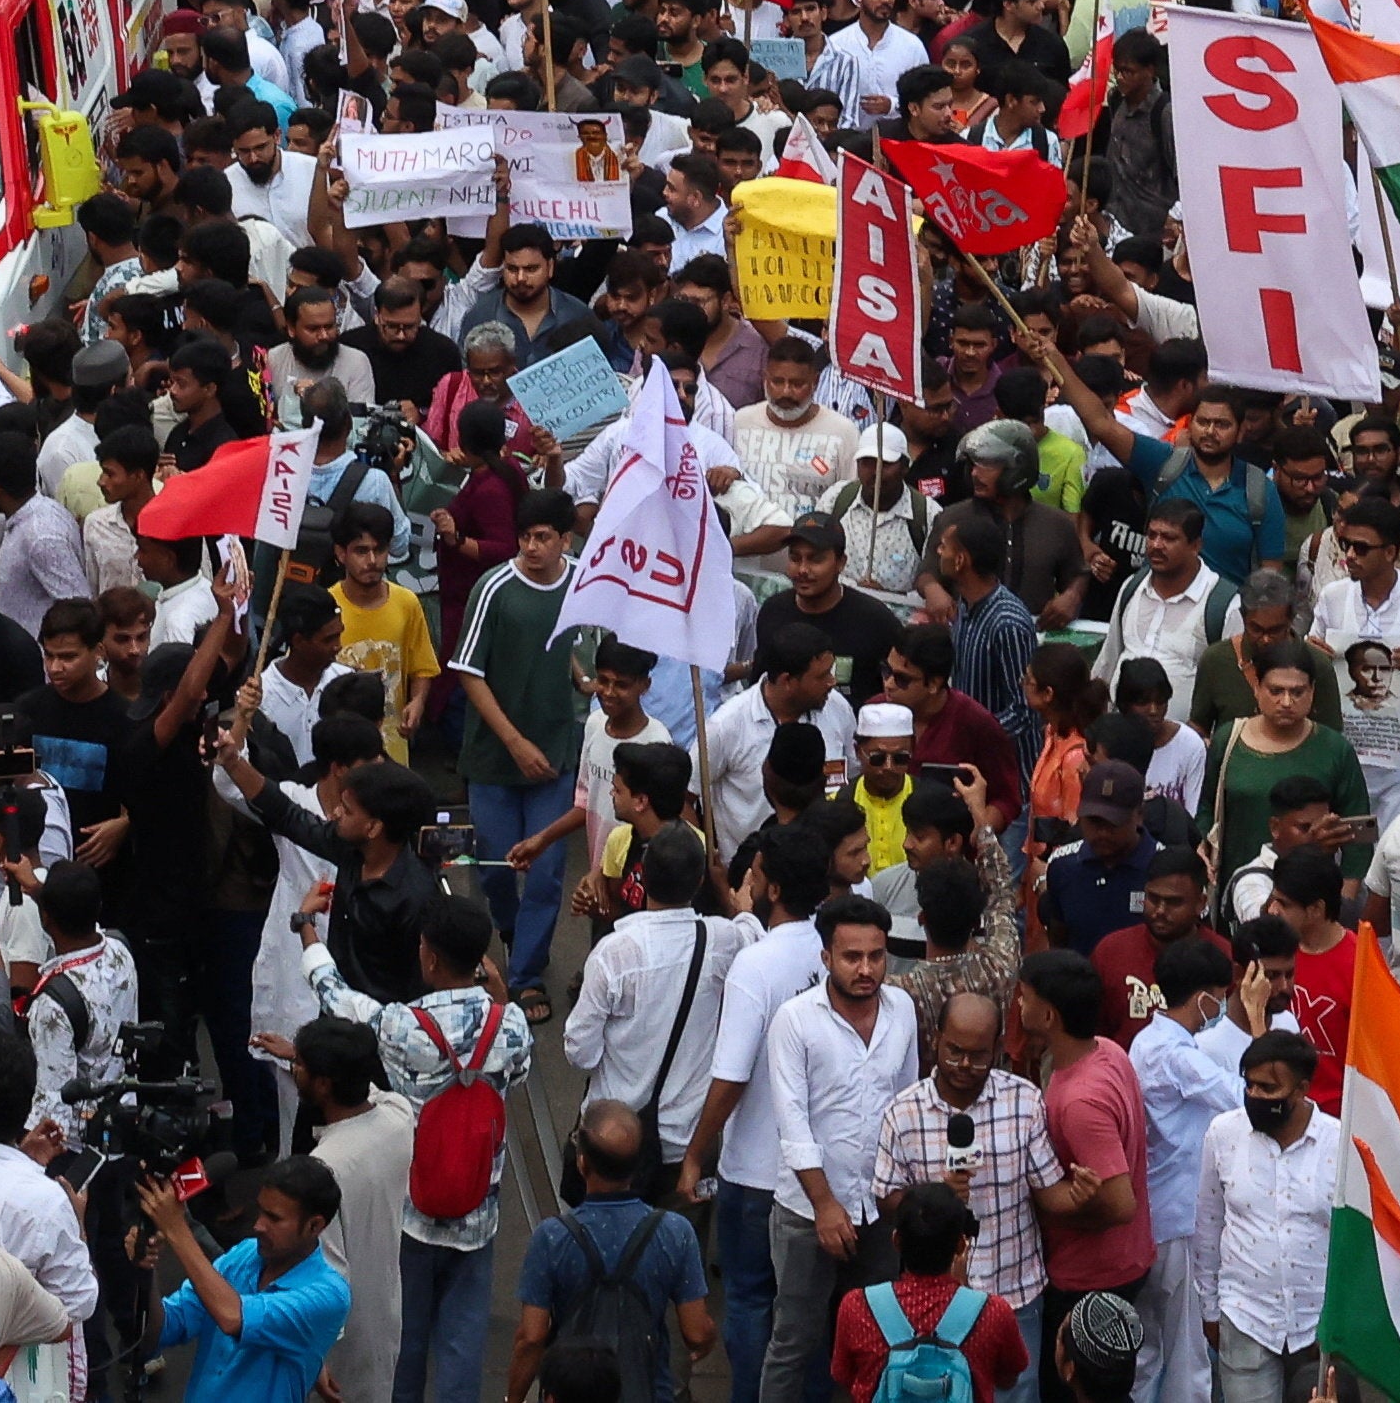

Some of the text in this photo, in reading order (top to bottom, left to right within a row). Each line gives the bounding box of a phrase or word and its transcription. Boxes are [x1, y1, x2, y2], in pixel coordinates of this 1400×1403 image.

[443, 112, 508, 129] ISTIFA
[503, 126, 535, 143] DO
[357, 142, 494, 174] MUTH MARO
[345, 187, 442, 215] STUDENT
[510, 201, 601, 222] KUCCHU
[1202, 31, 1306, 373] SFI
[849, 171, 903, 381] AISA
[517, 358, 566, 395] SUPPORT
[528, 401, 557, 423] SAVE
[566, 387, 618, 423] COUNTRY
[735, 430, 844, 457] SERVICE
